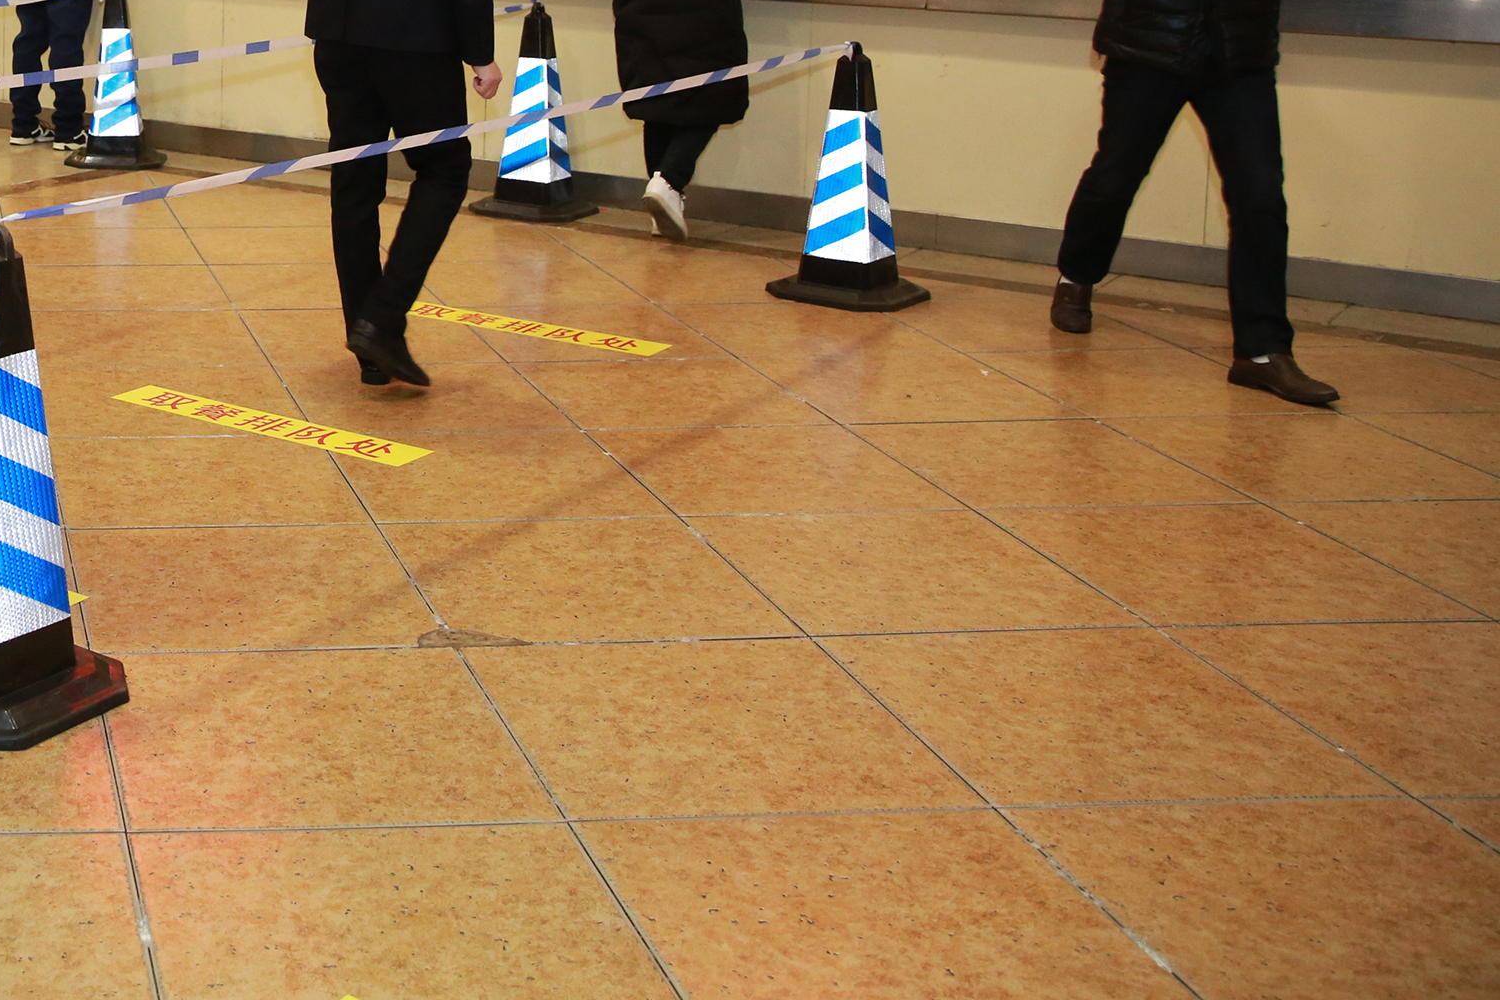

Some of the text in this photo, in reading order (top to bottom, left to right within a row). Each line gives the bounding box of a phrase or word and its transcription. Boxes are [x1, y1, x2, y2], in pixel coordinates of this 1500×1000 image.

[412, 304, 638, 351] 取餐排队处
[141, 391, 392, 459] 取餐排队处
